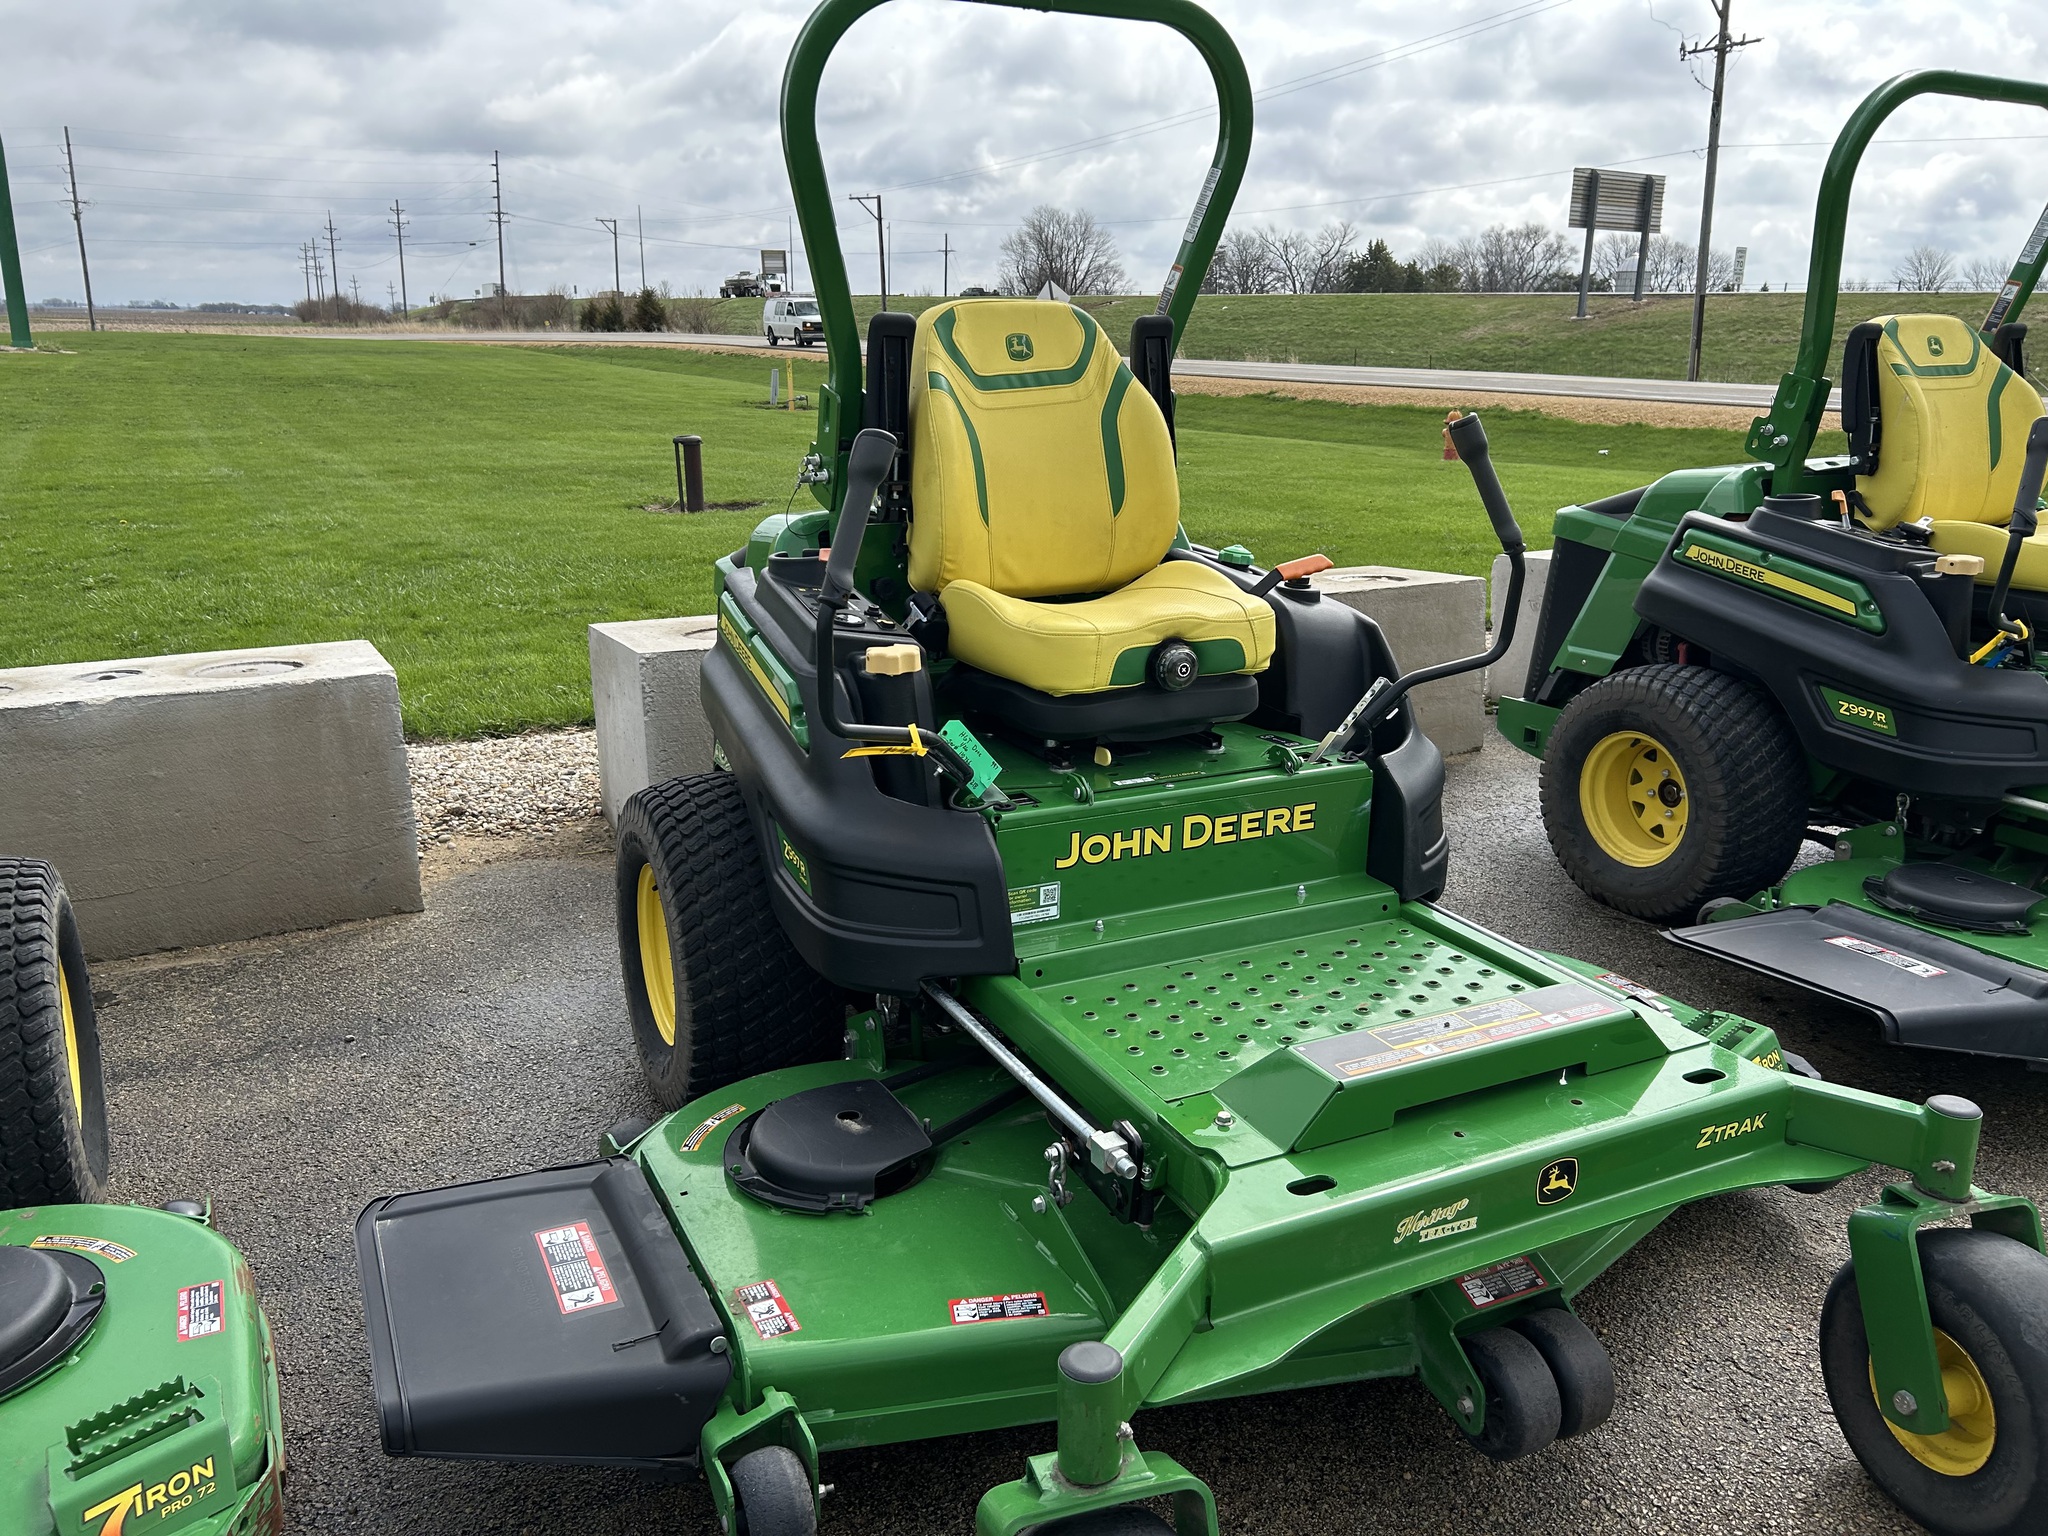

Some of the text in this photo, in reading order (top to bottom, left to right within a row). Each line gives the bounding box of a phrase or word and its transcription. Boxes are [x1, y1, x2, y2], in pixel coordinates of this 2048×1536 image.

[1736, 260, 1744, 268] 70
[1694, 549, 1765, 581] JOHN DEERE
[1055, 801, 1317, 870] JOHN DEERE
[1696, 1111, 1769, 1149] ZTRAK
[1393, 1197, 1470, 1244] Heritage
[1419, 1217, 1477, 1242] TRACTOR
[1011, 1292, 1038, 1300] PELIGRO
[161, 1482, 216, 1519] PRO 72
